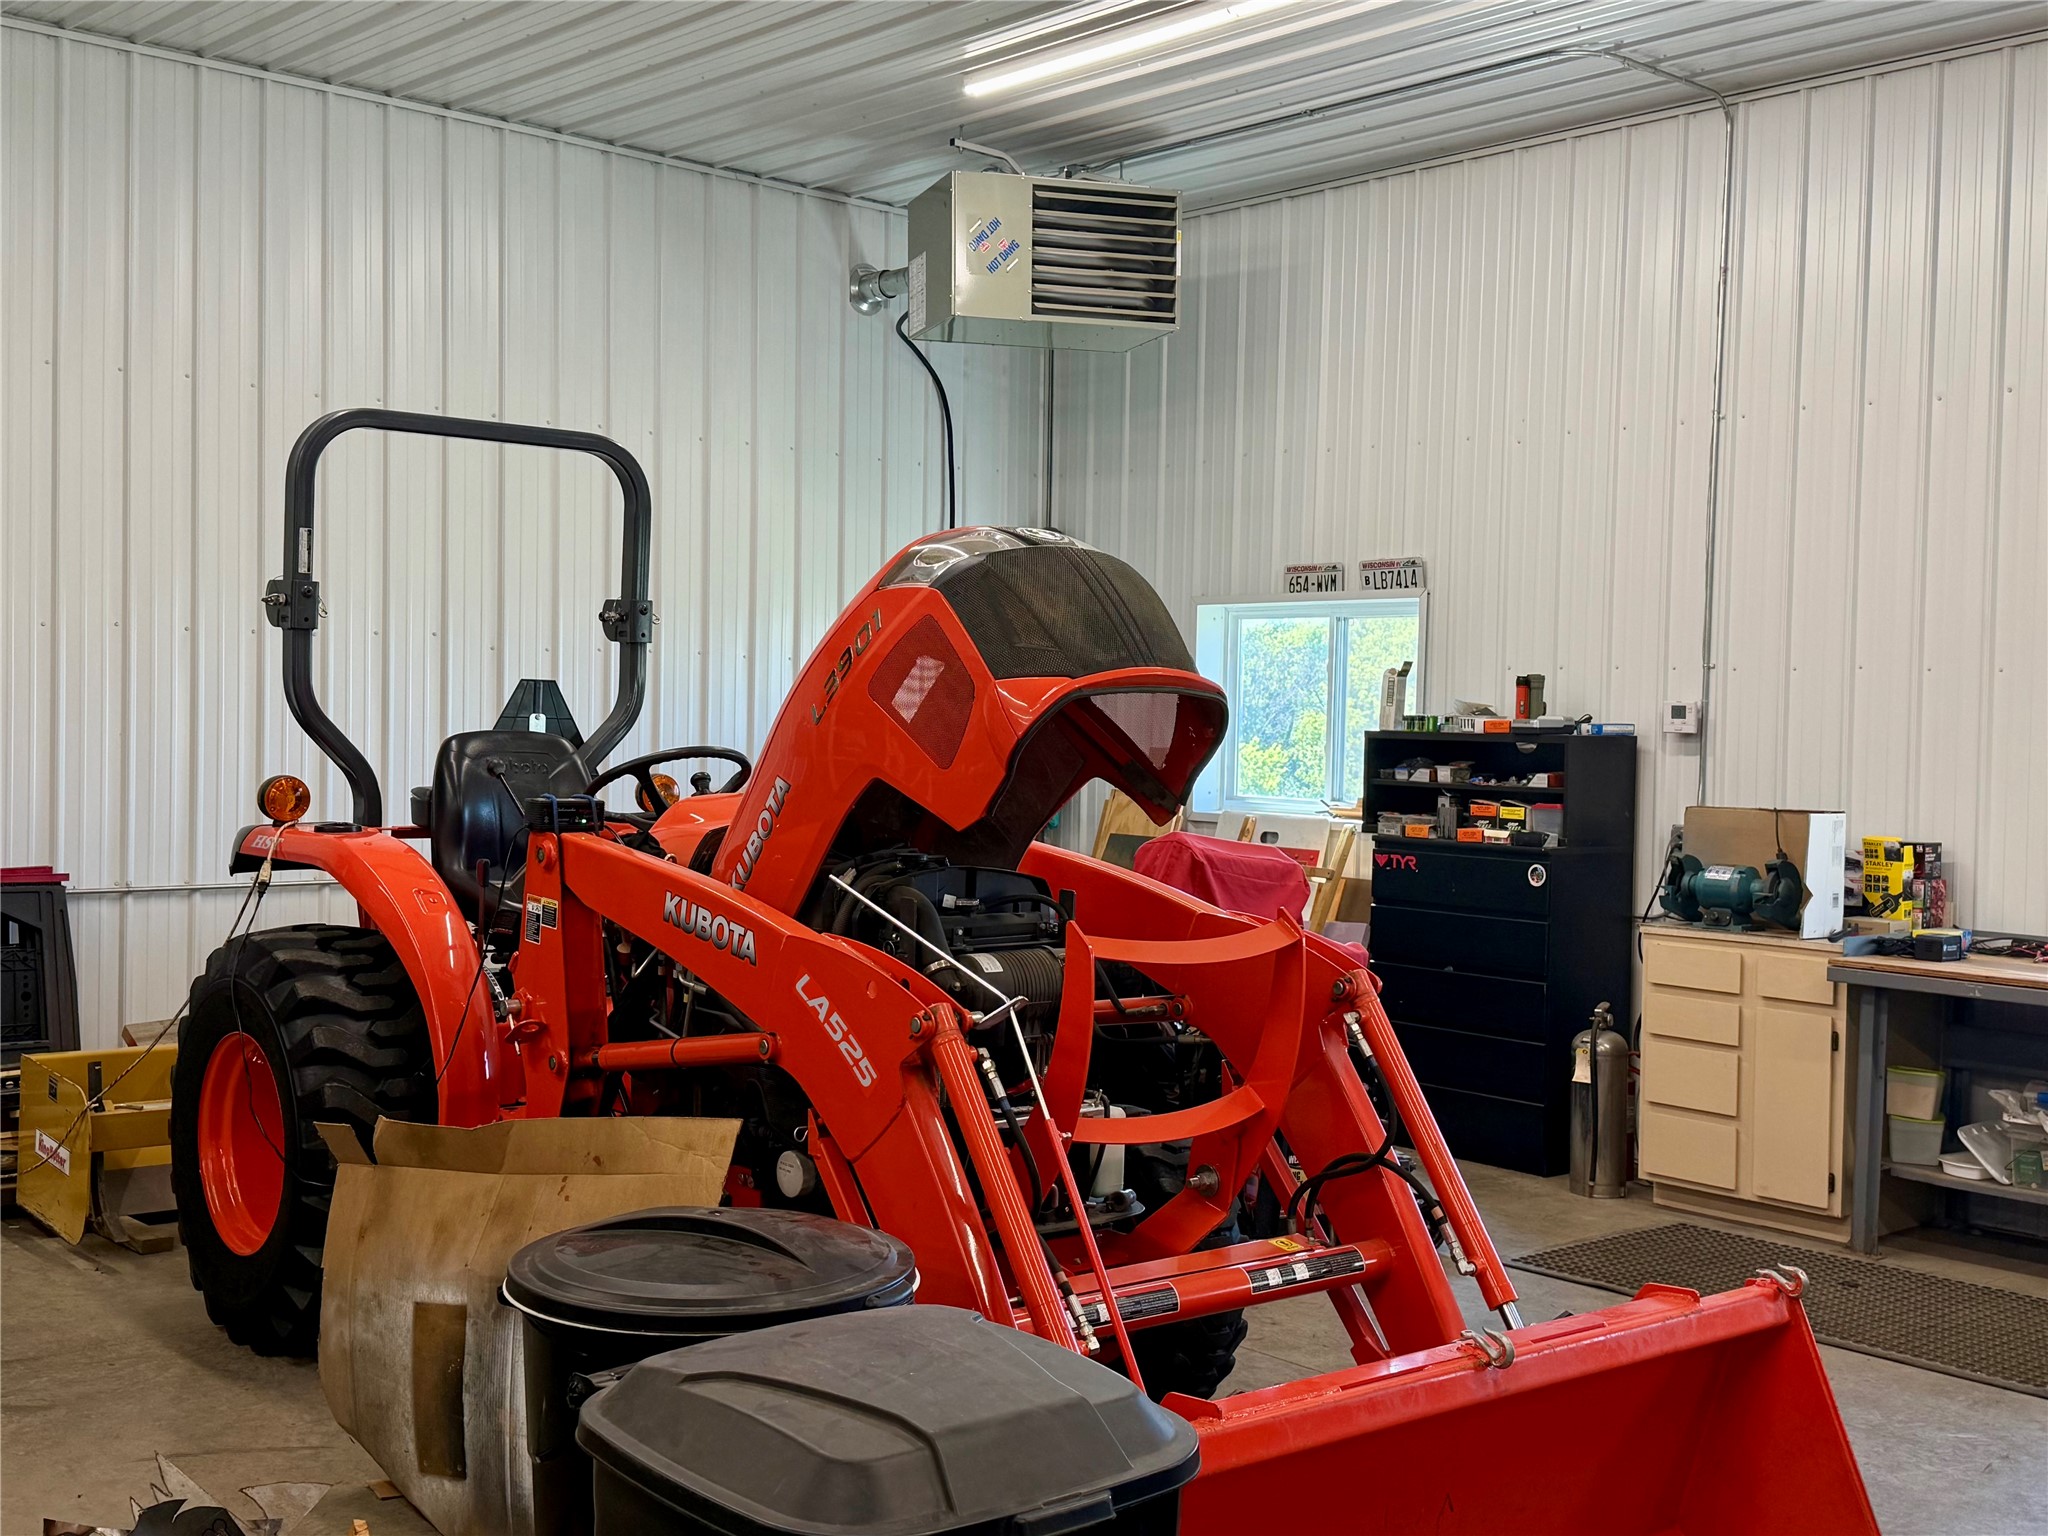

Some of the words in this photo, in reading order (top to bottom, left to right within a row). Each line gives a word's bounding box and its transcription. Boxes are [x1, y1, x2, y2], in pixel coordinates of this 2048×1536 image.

[986, 217, 1002, 235] HOT
[986, 257, 1002, 274] HOT
[998, 239, 1020, 262] DAWG
[1286, 565, 1317, 573] WISCONSIN
[1362, 561, 1395, 569] WISCONSIN
[1364, 576, 1371, 586] B
[1373, 569, 1418, 590] LB7414
[810, 607, 883, 726] L3901
[729, 775, 792, 892] KUBOTA
[1390, 854, 1417, 870] TYR
[1865, 860, 1894, 868] STANLEY
[662, 890, 757, 967] KUBOTA
[795, 973, 878, 1088] LA525
